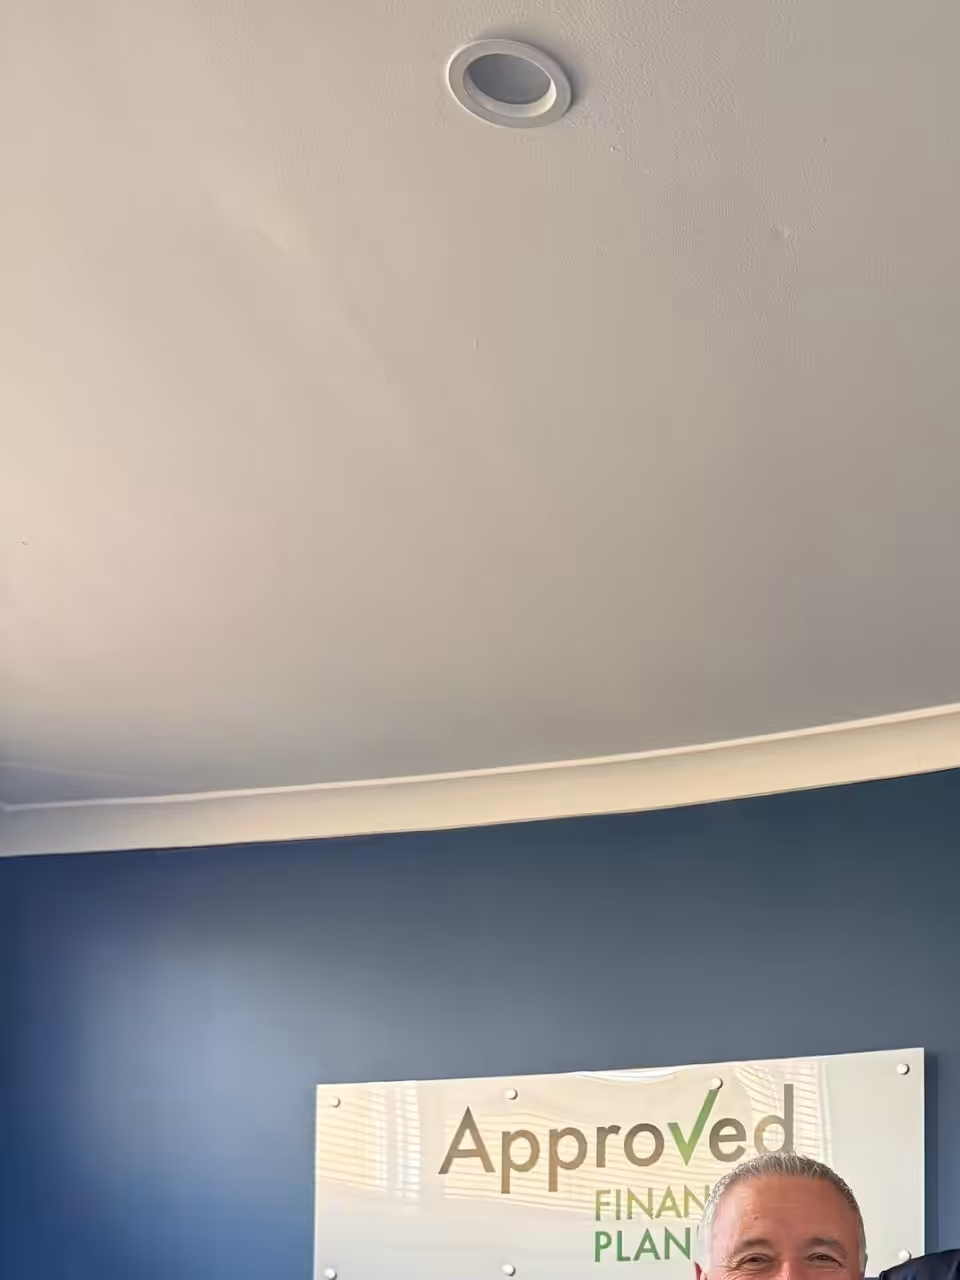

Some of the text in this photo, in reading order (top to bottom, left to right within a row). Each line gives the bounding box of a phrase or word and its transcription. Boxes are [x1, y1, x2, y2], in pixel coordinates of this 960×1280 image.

[438, 1083, 794, 1194] Approved
[595, 1184, 710, 1221] FINAN
[594, 1226, 692, 1262] PLAN
